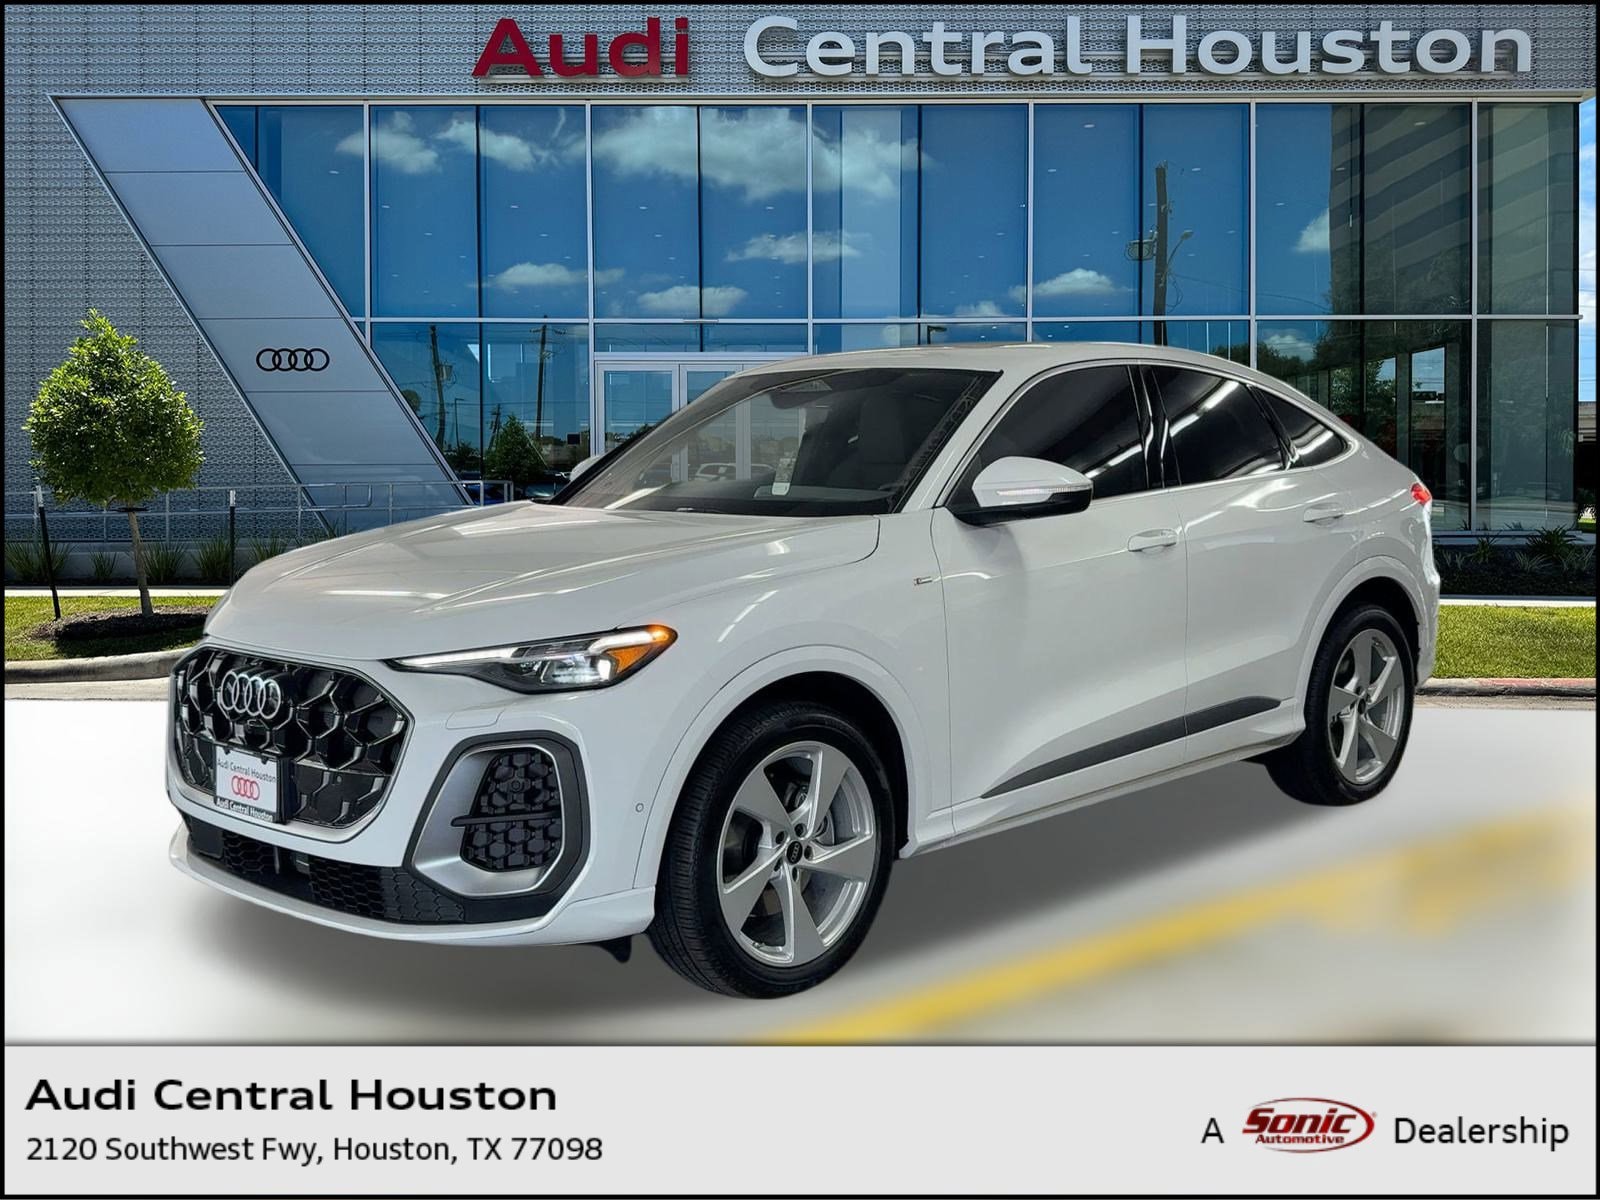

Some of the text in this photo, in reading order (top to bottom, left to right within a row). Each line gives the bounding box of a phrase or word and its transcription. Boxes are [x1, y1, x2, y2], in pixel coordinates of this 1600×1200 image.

[472, 15, 1532, 77] Audi Central Houston
[217, 759, 277, 783] Audi Central Houston
[230, 801, 250, 816] Central
[250, 806, 274, 822] Houston
